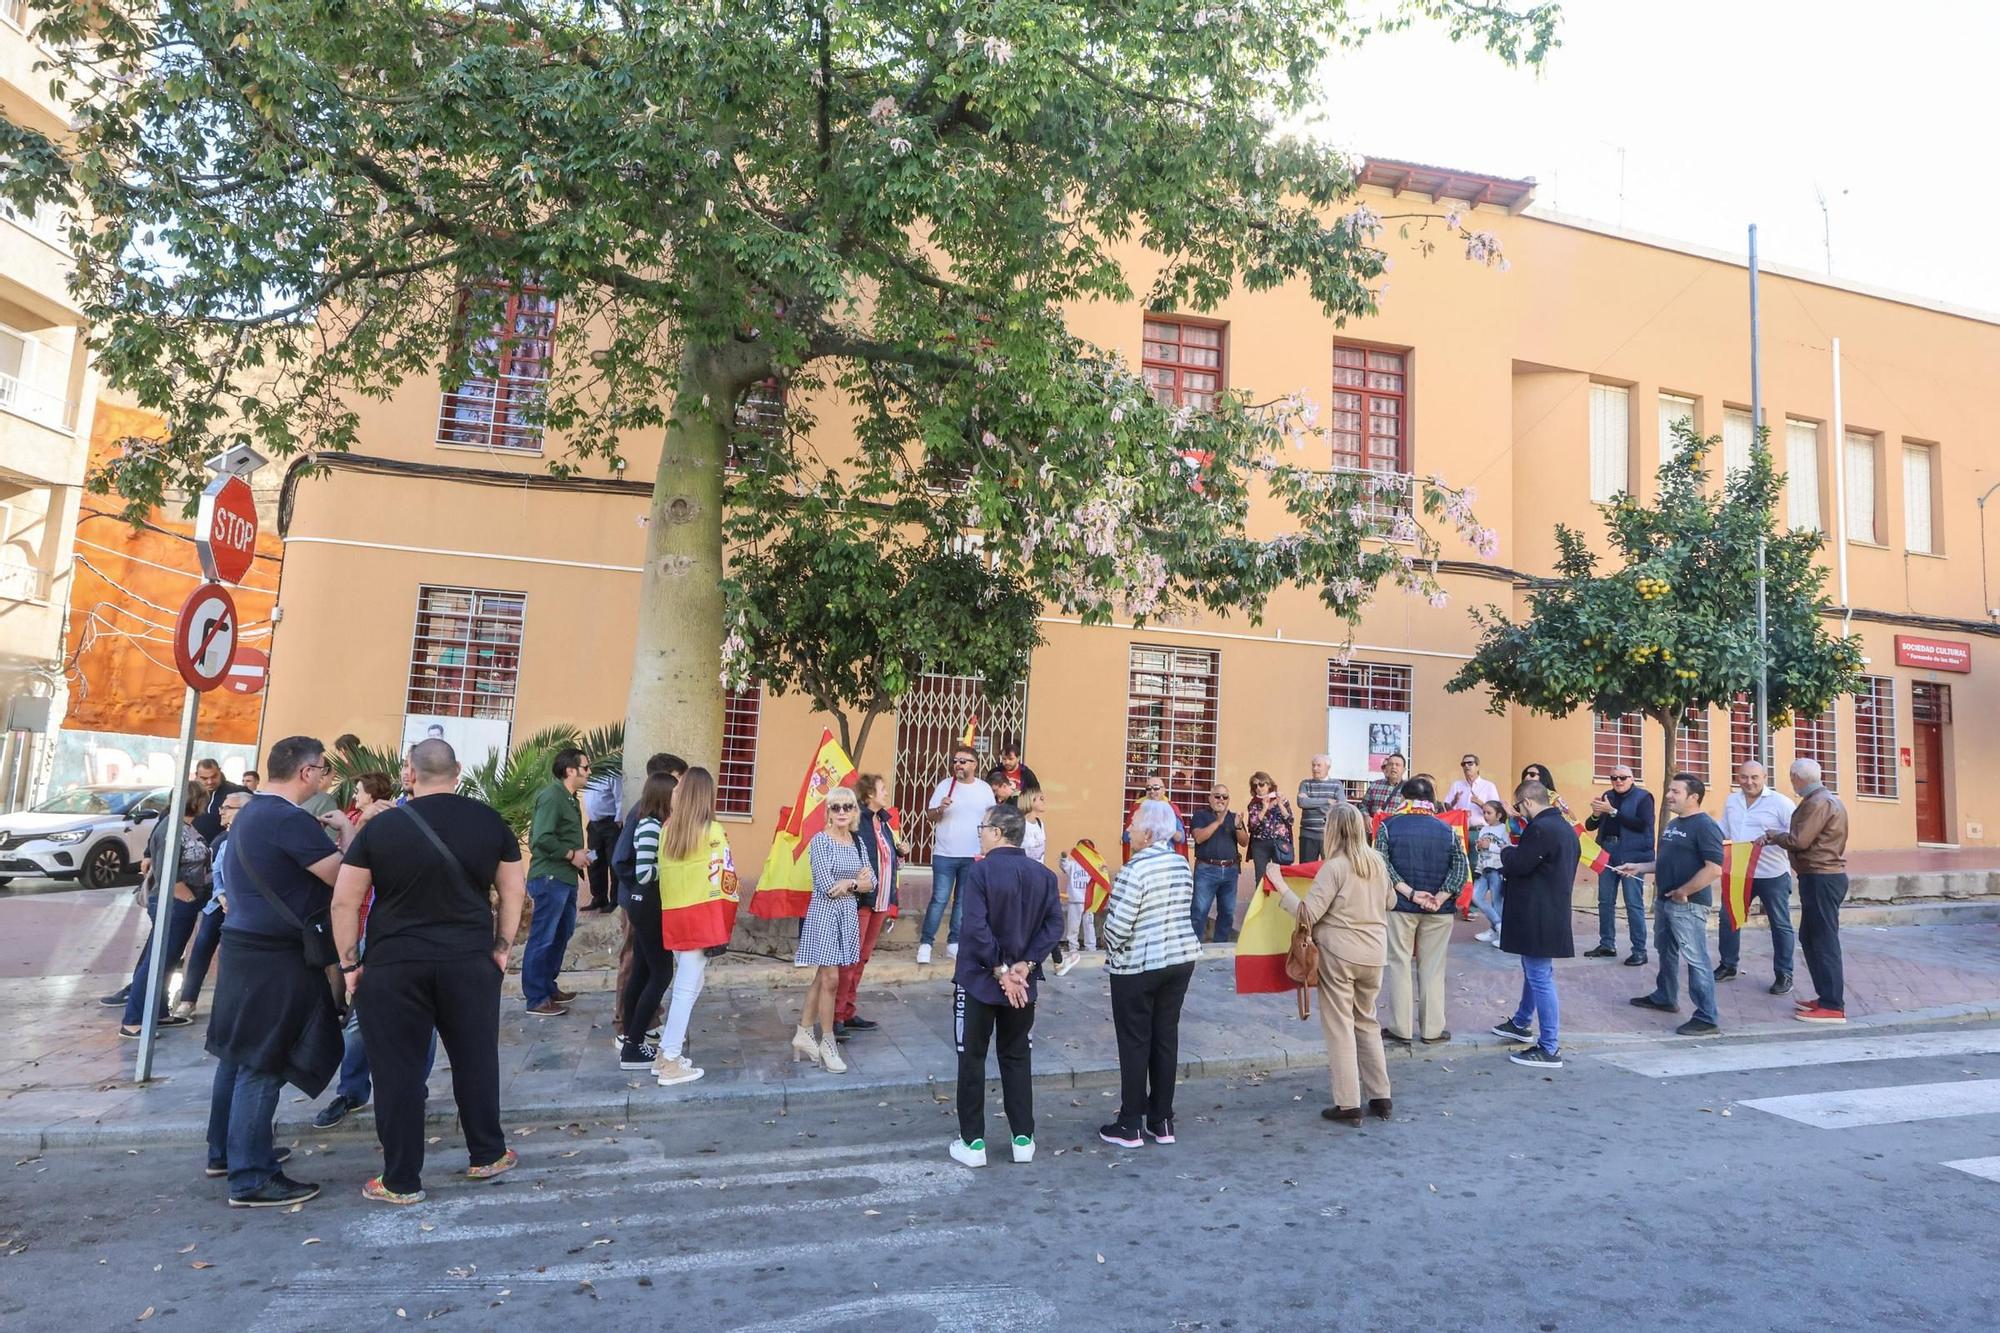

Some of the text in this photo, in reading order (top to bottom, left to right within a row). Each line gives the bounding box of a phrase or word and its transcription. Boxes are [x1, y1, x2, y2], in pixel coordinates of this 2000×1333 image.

[214, 508, 254, 552] STOP
[1902, 643, 1967, 657] SOCIEDAD CULTURAL
